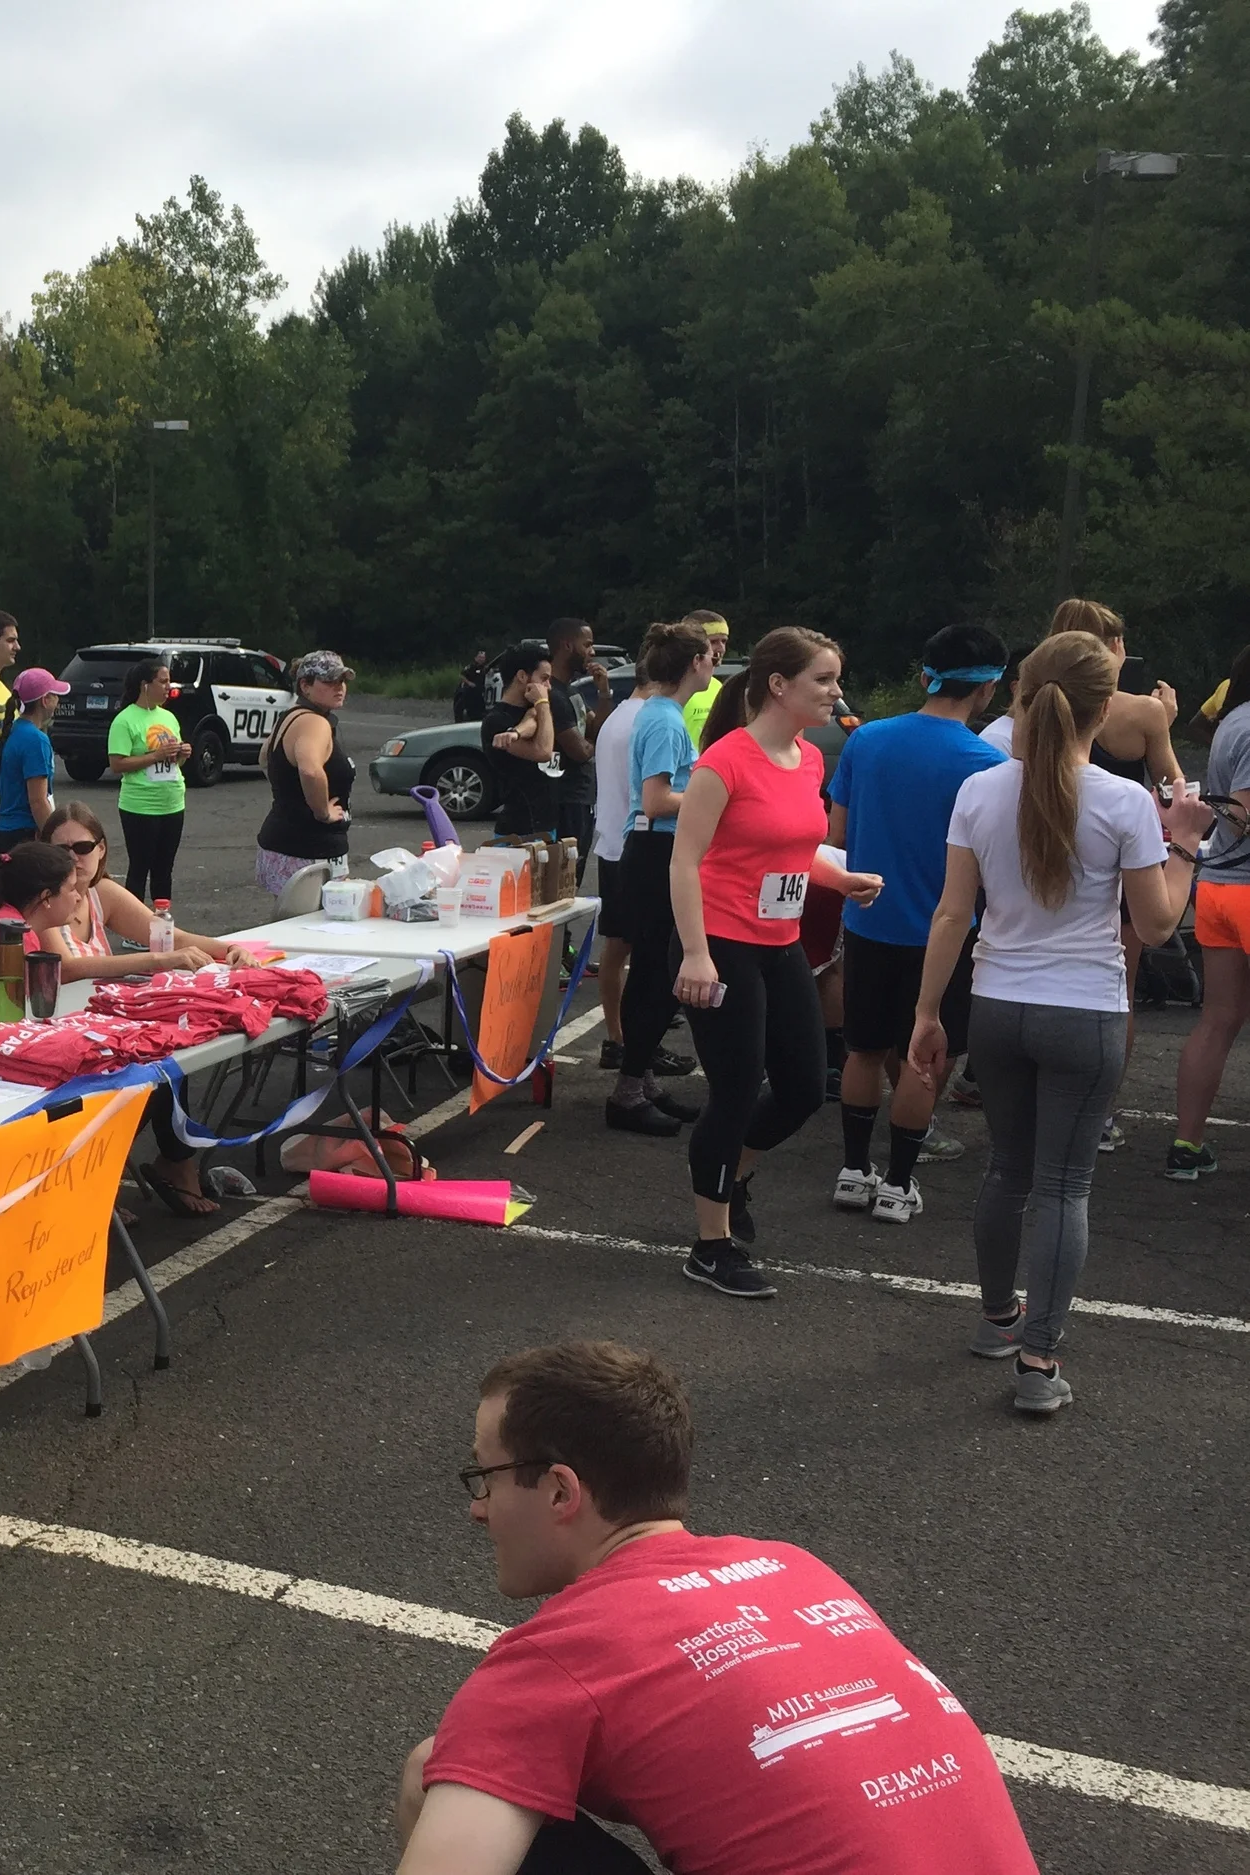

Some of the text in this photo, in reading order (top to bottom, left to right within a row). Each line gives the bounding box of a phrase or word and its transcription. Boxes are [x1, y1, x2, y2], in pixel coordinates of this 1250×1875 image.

[233, 708, 286, 739] POLI
[154, 757, 171, 774] 179
[776, 873, 804, 902] 146
[840, 1184, 856, 1192] NIKE
[879, 1199, 896, 1209] NIKE
[23, 1221, 57, 1254] for
[657, 1556, 787, 1592] 2015 DONORS:
[675, 1617, 754, 1654] Hartford
[688, 1629, 768, 1671] Hospital
[711, 1657, 742, 1678] Hartford
[766, 1677, 877, 1723] MJLF & ASSOCIATES
[860, 1753, 961, 1800] DELAMAR
[909, 1776, 958, 1799] HARTFORD
